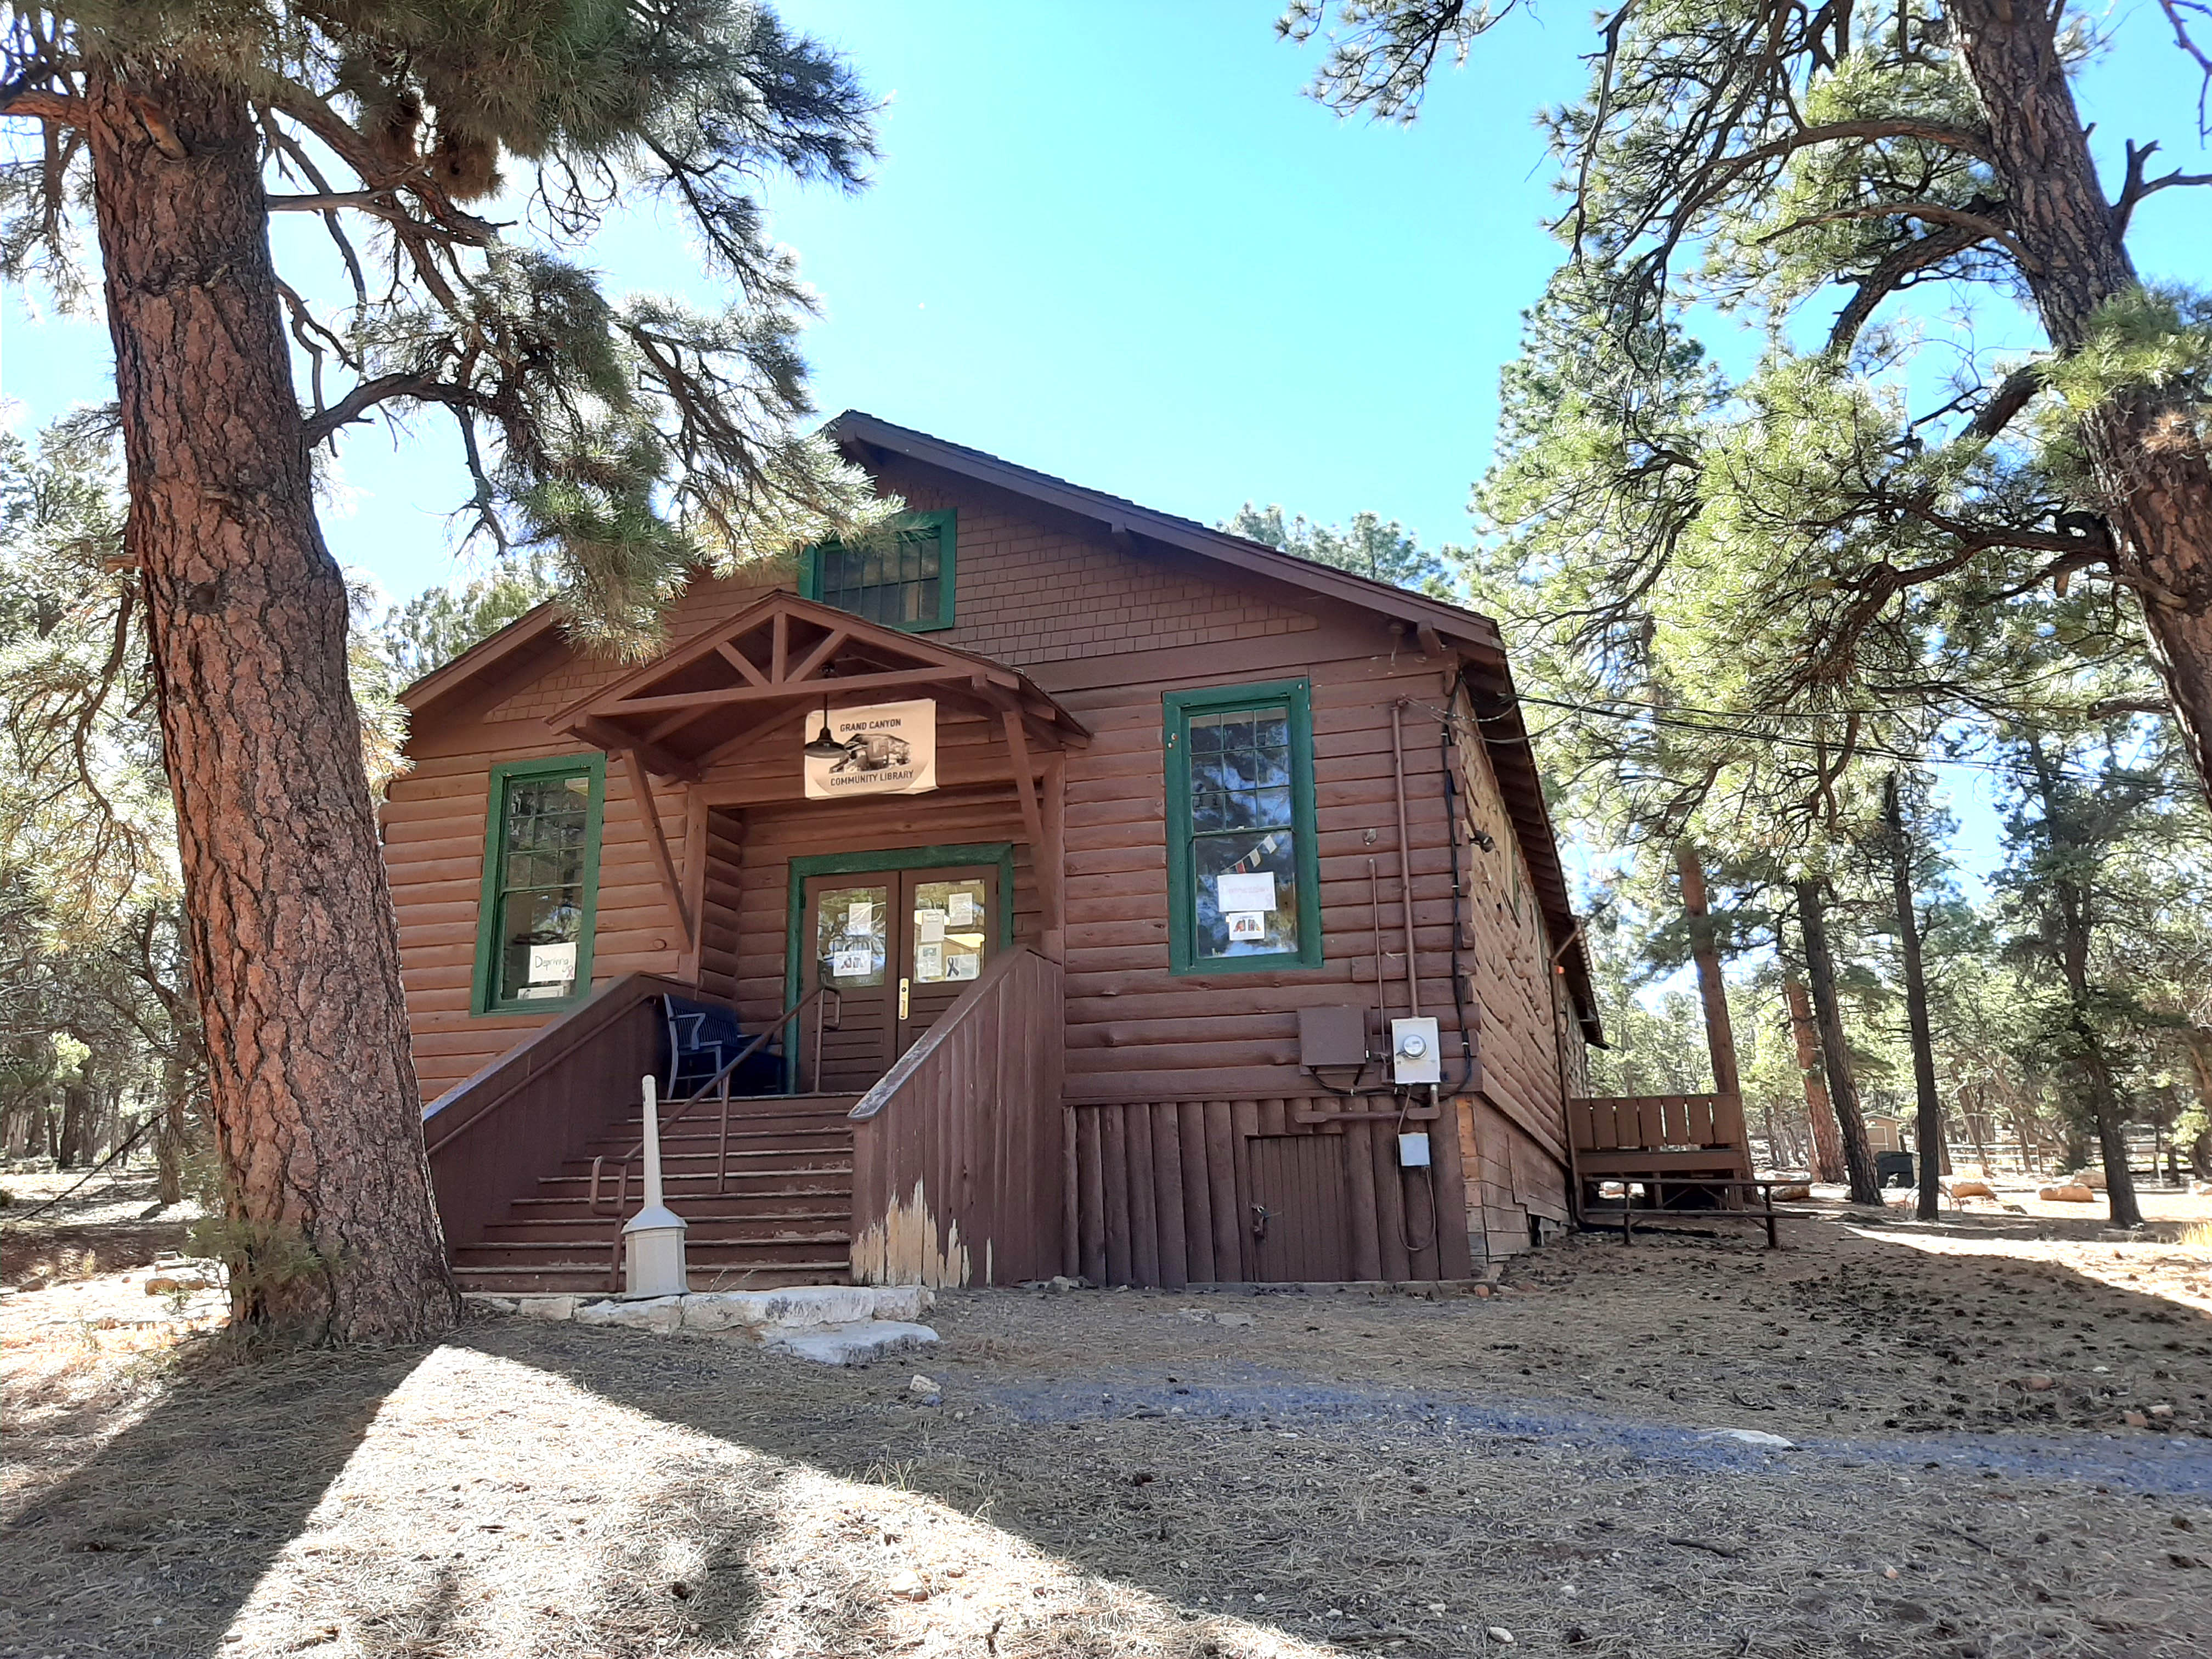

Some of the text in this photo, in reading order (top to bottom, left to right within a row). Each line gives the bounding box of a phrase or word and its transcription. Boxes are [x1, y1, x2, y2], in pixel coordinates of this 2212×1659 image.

[840, 719, 901, 732] GRAND CANYON
[831, 770, 913, 786] COMMUNITY LIBRARY
